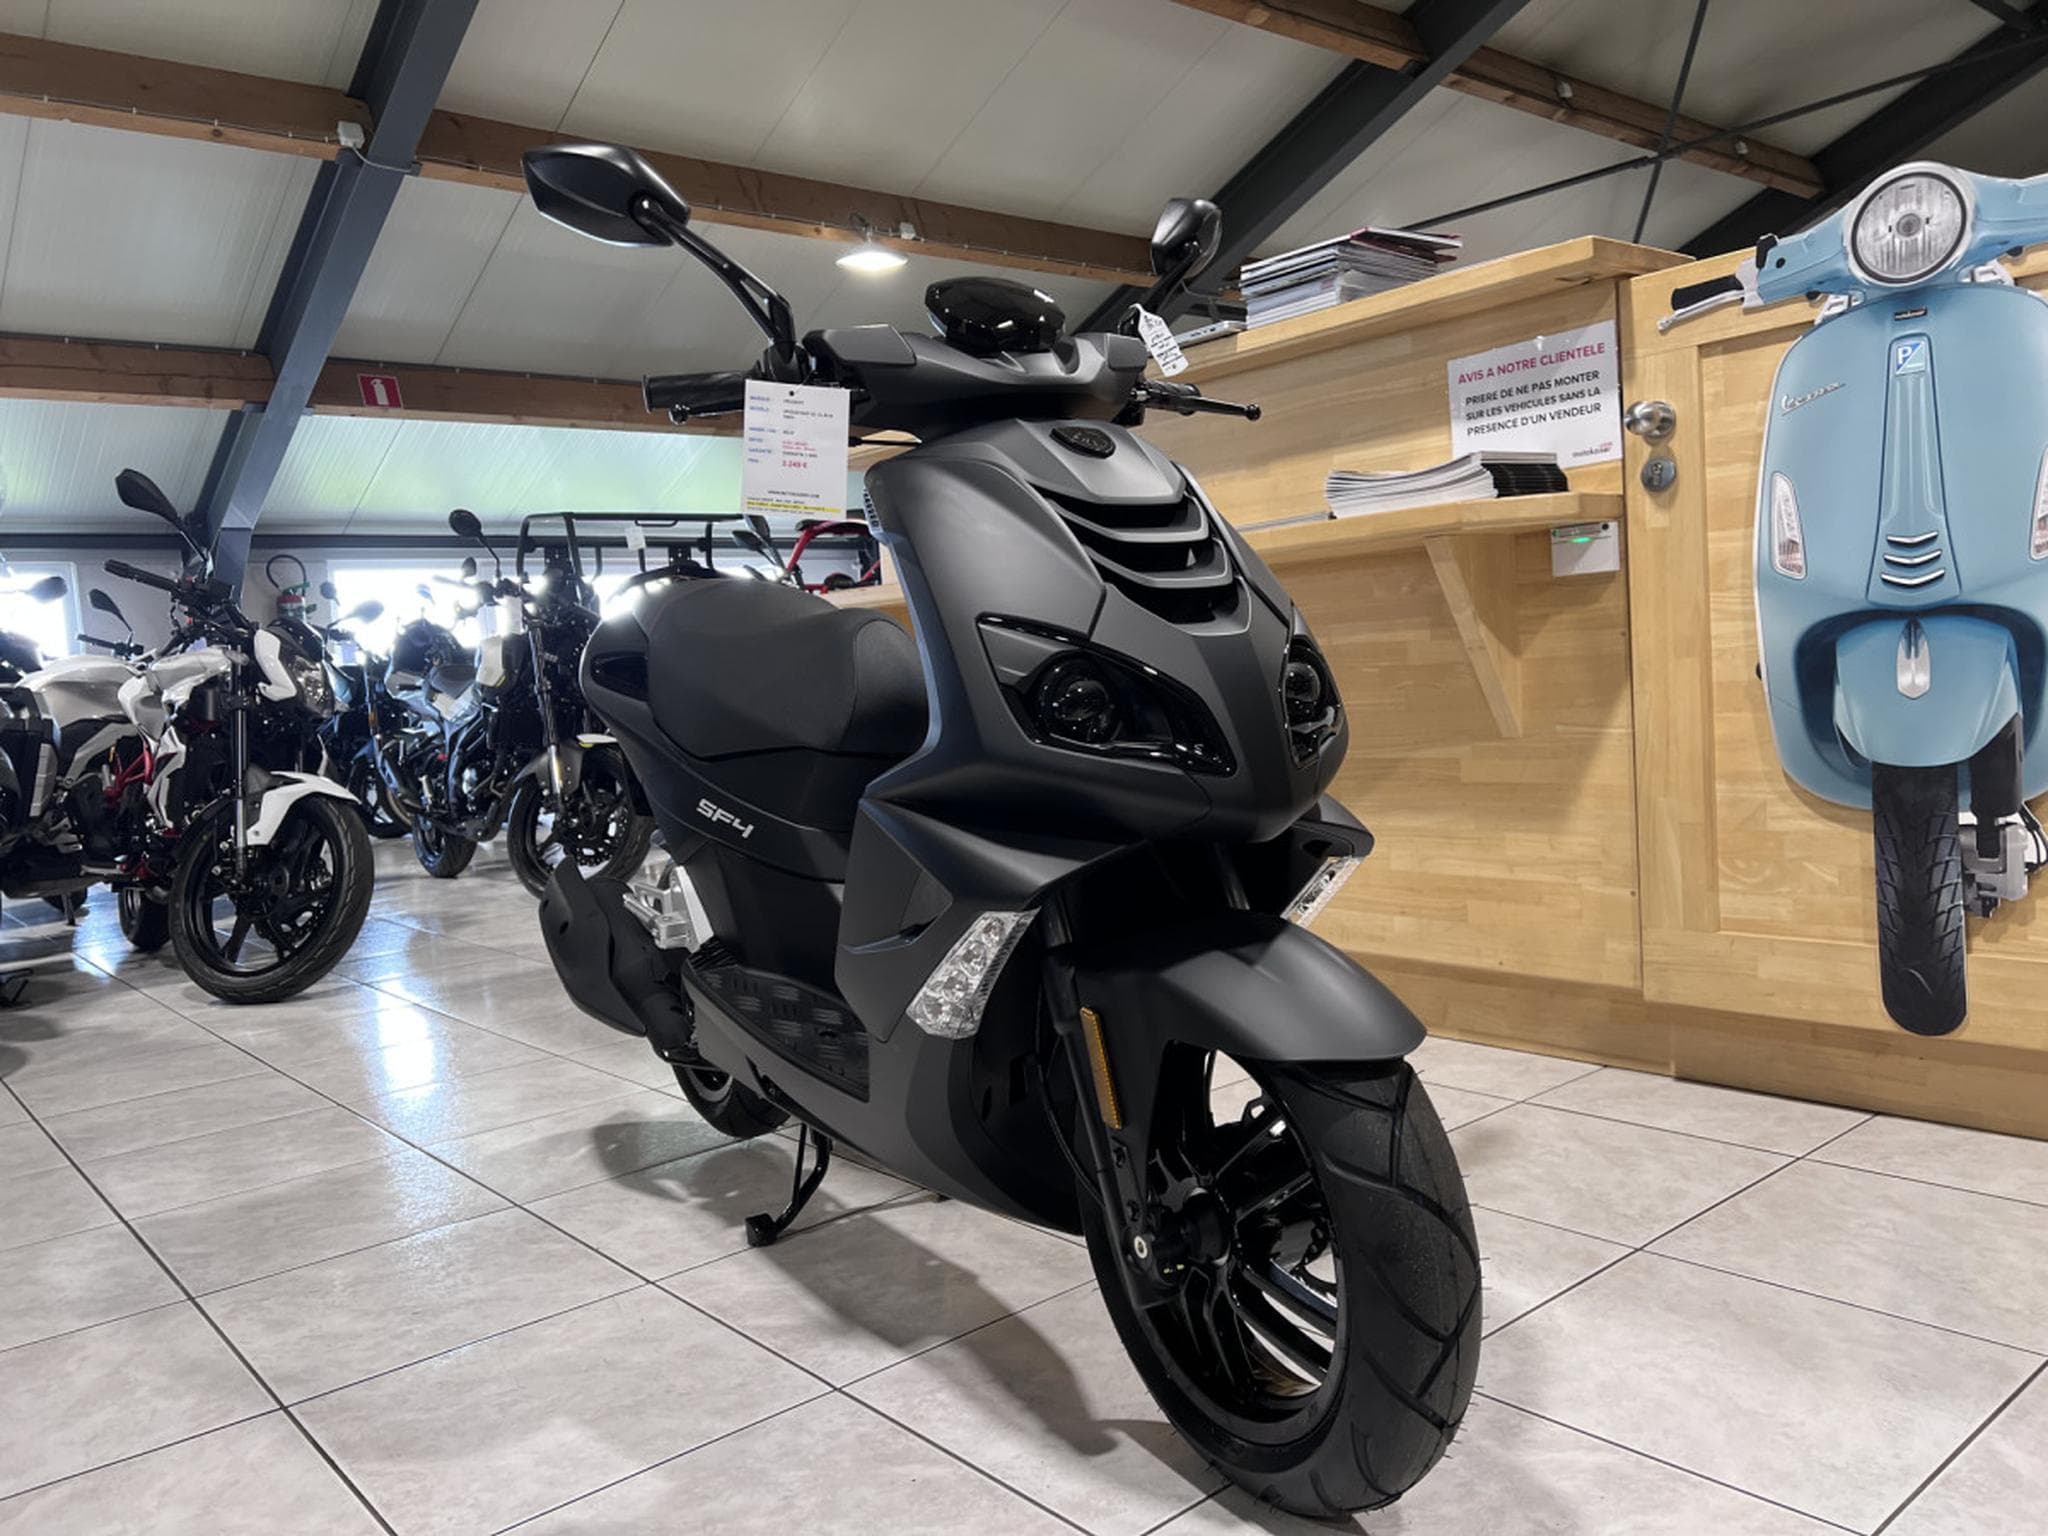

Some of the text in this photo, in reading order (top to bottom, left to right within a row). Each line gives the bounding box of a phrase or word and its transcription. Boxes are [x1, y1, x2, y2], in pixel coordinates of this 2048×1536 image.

[1458, 342, 1605, 384] AVIS A NOTRE CLIENTELE
[1465, 370, 1600, 406] PRIERE DE NE PAS MONTER
[1466, 386, 1601, 421] SUR LES VEHICULES SANS LA
[1782, 383, 1842, 408] Vespa
[1467, 402, 1602, 436] PRESENCE D'UN VENDEUR
[695, 798, 755, 839] SF4
